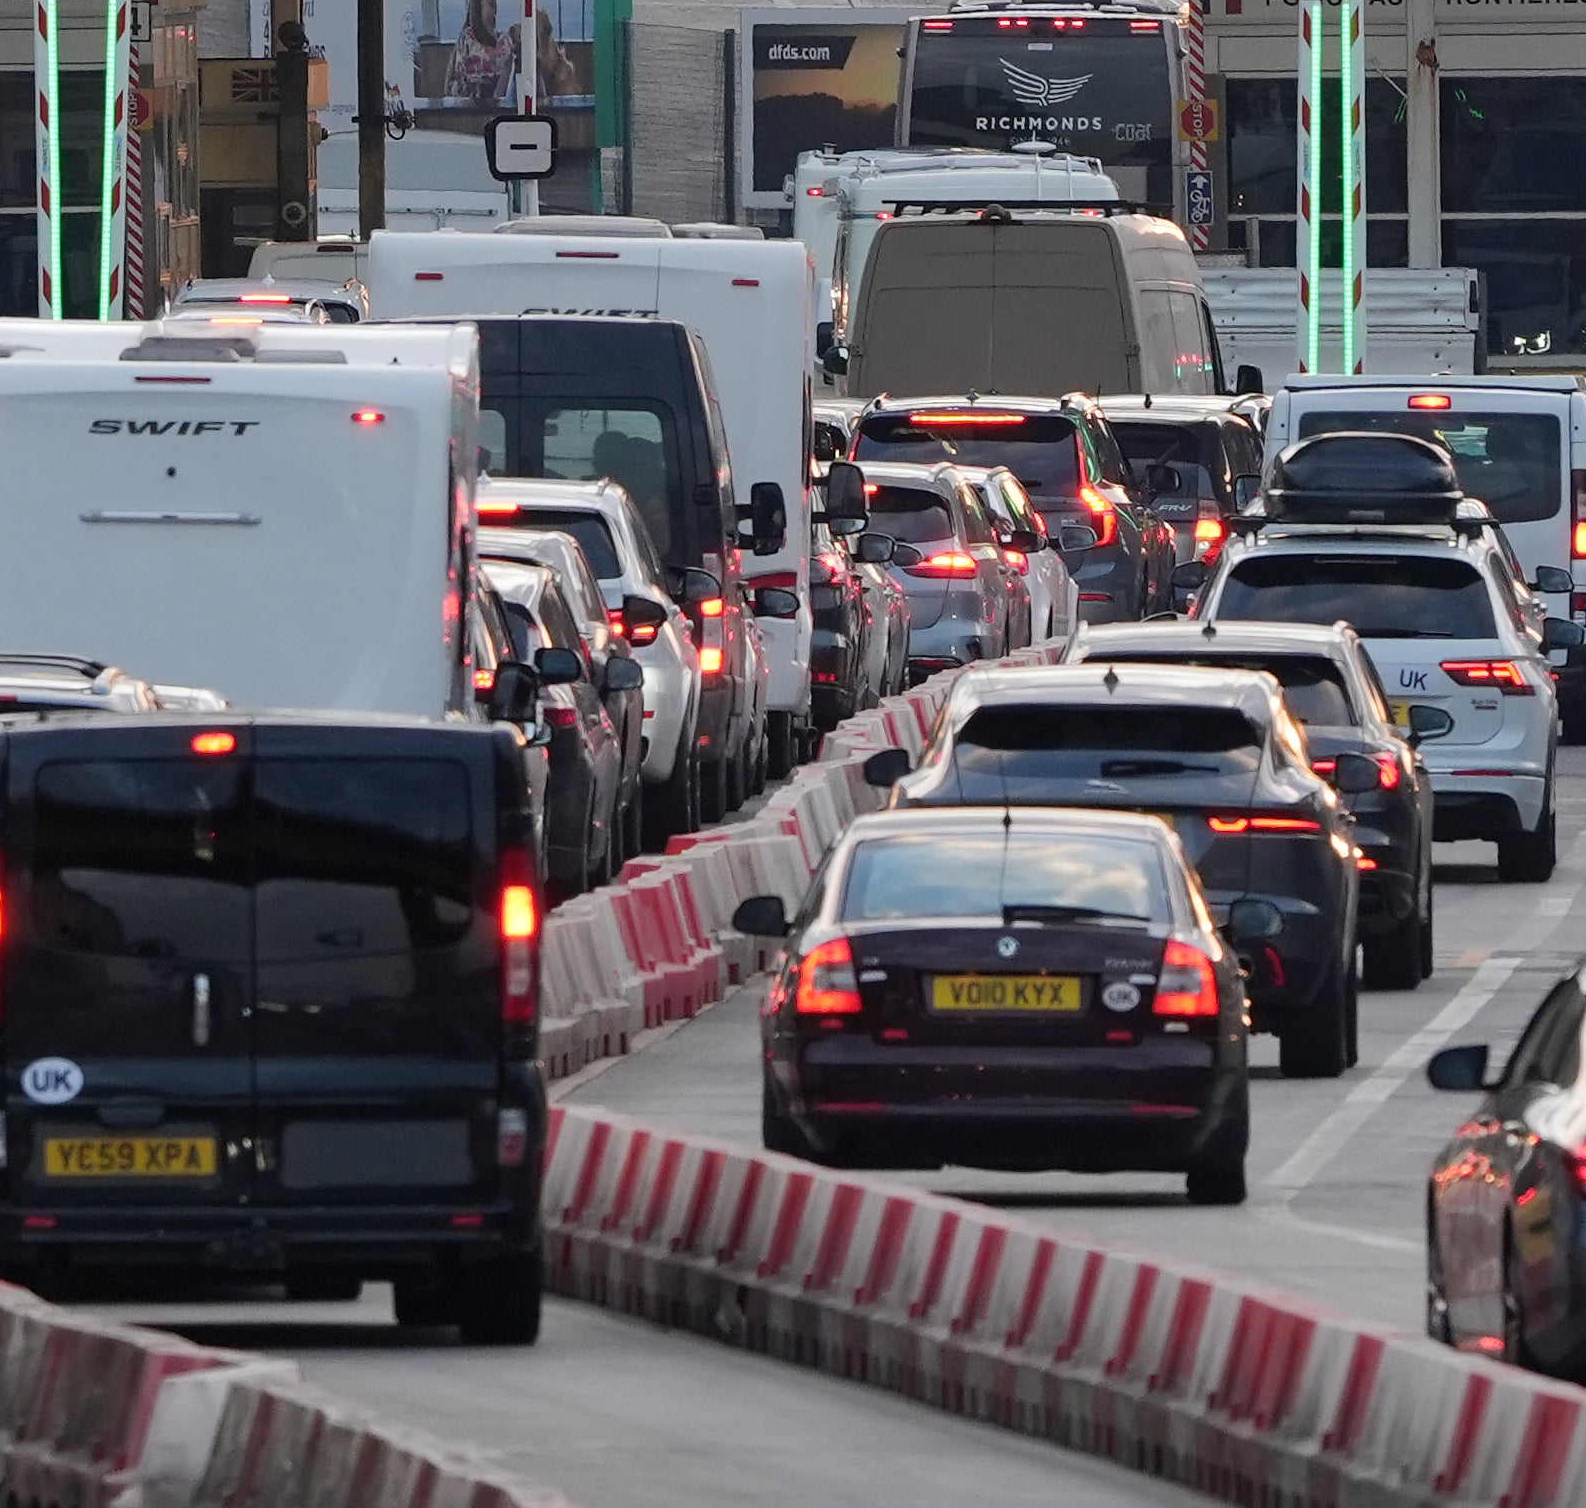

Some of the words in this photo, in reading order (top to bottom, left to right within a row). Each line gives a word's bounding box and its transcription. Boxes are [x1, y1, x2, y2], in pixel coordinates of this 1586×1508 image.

[768, 43, 831, 61] dfds.com
[127, 92, 139, 127] STOP
[975, 116, 1103, 131] RICHMONDS
[1191, 103, 1204, 141] STOP
[88, 419, 261, 436] SWIFT
[1399, 667, 1428, 691] UK
[1013, 981, 1064, 1005] KYX
[32, 1069, 73, 1092] UK
[144, 1142, 202, 1170] XPA
